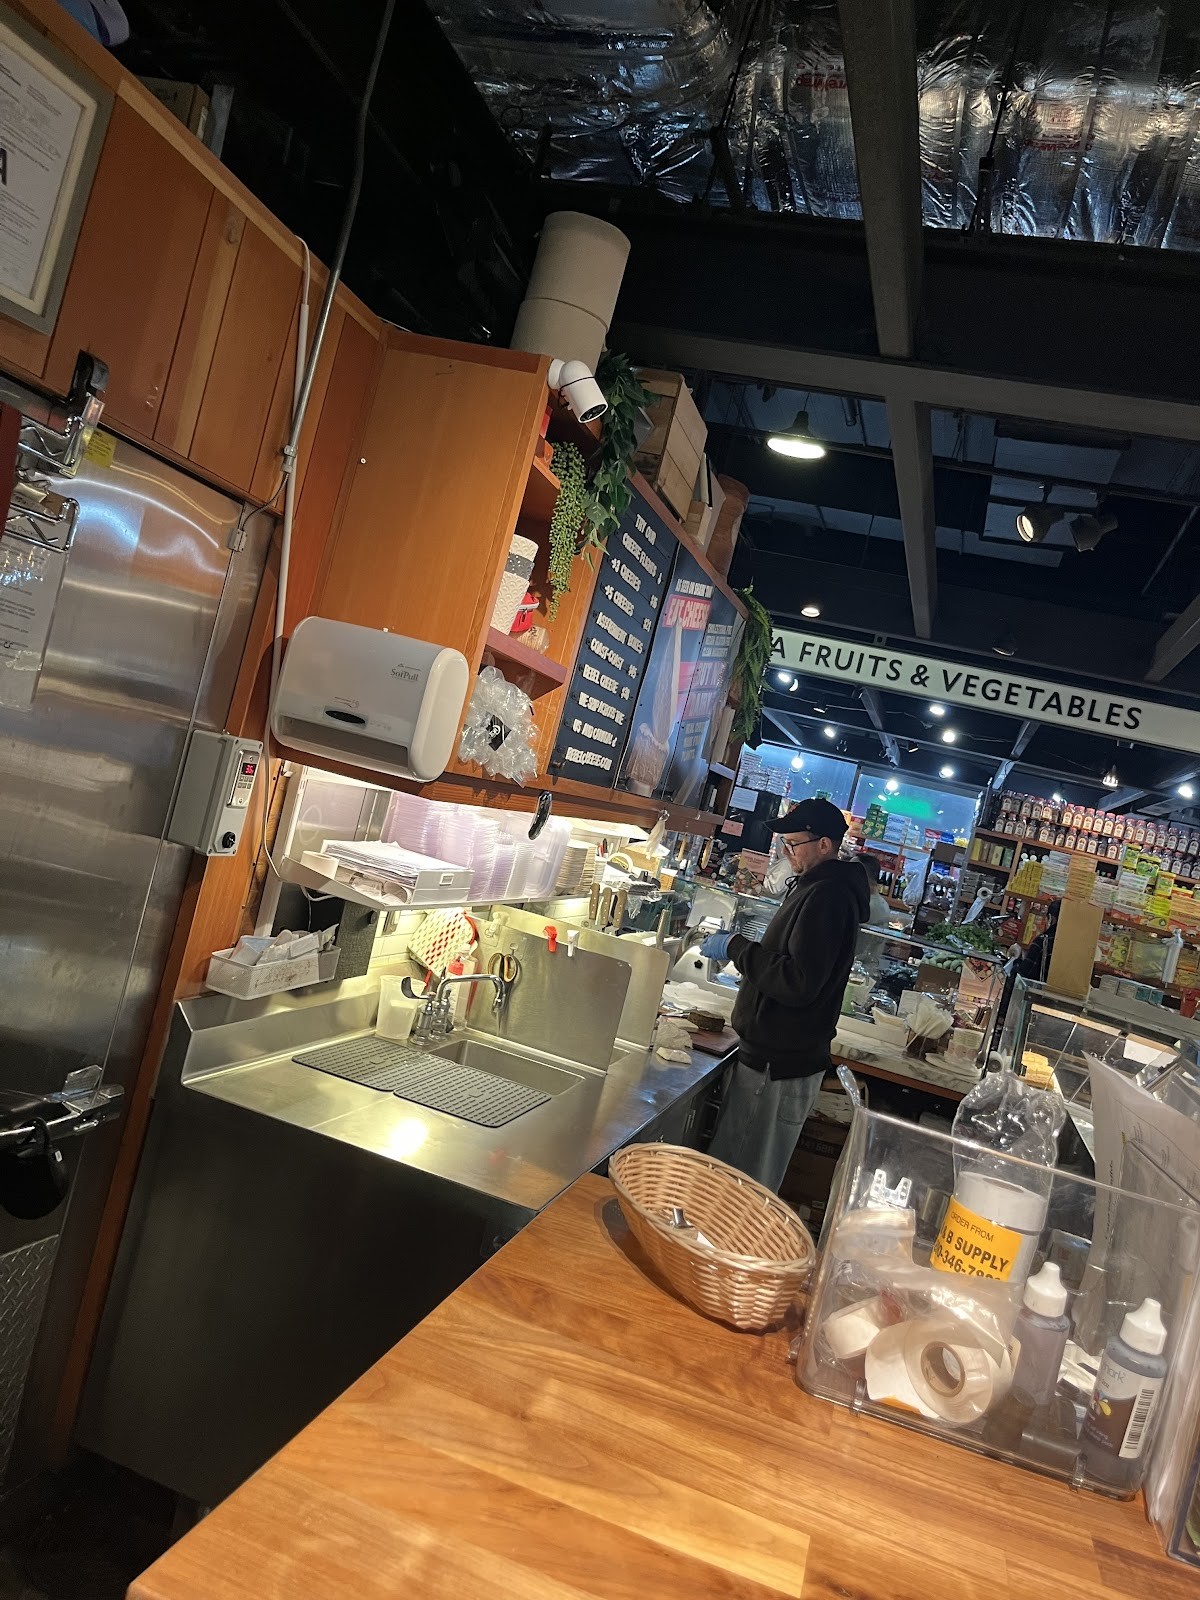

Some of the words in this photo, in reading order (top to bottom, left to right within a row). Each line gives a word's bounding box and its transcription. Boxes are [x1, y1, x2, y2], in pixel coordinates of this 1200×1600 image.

[798, 641, 903, 681] FRUITS
[910, 664, 930, 688] &
[942, 669, 1142, 730] VEGETABLES
[950, 1211, 970, 1230] ORDER
[970, 1225, 995, 1242] FROM
[954, 1236, 1009, 1273] SUPPLY
